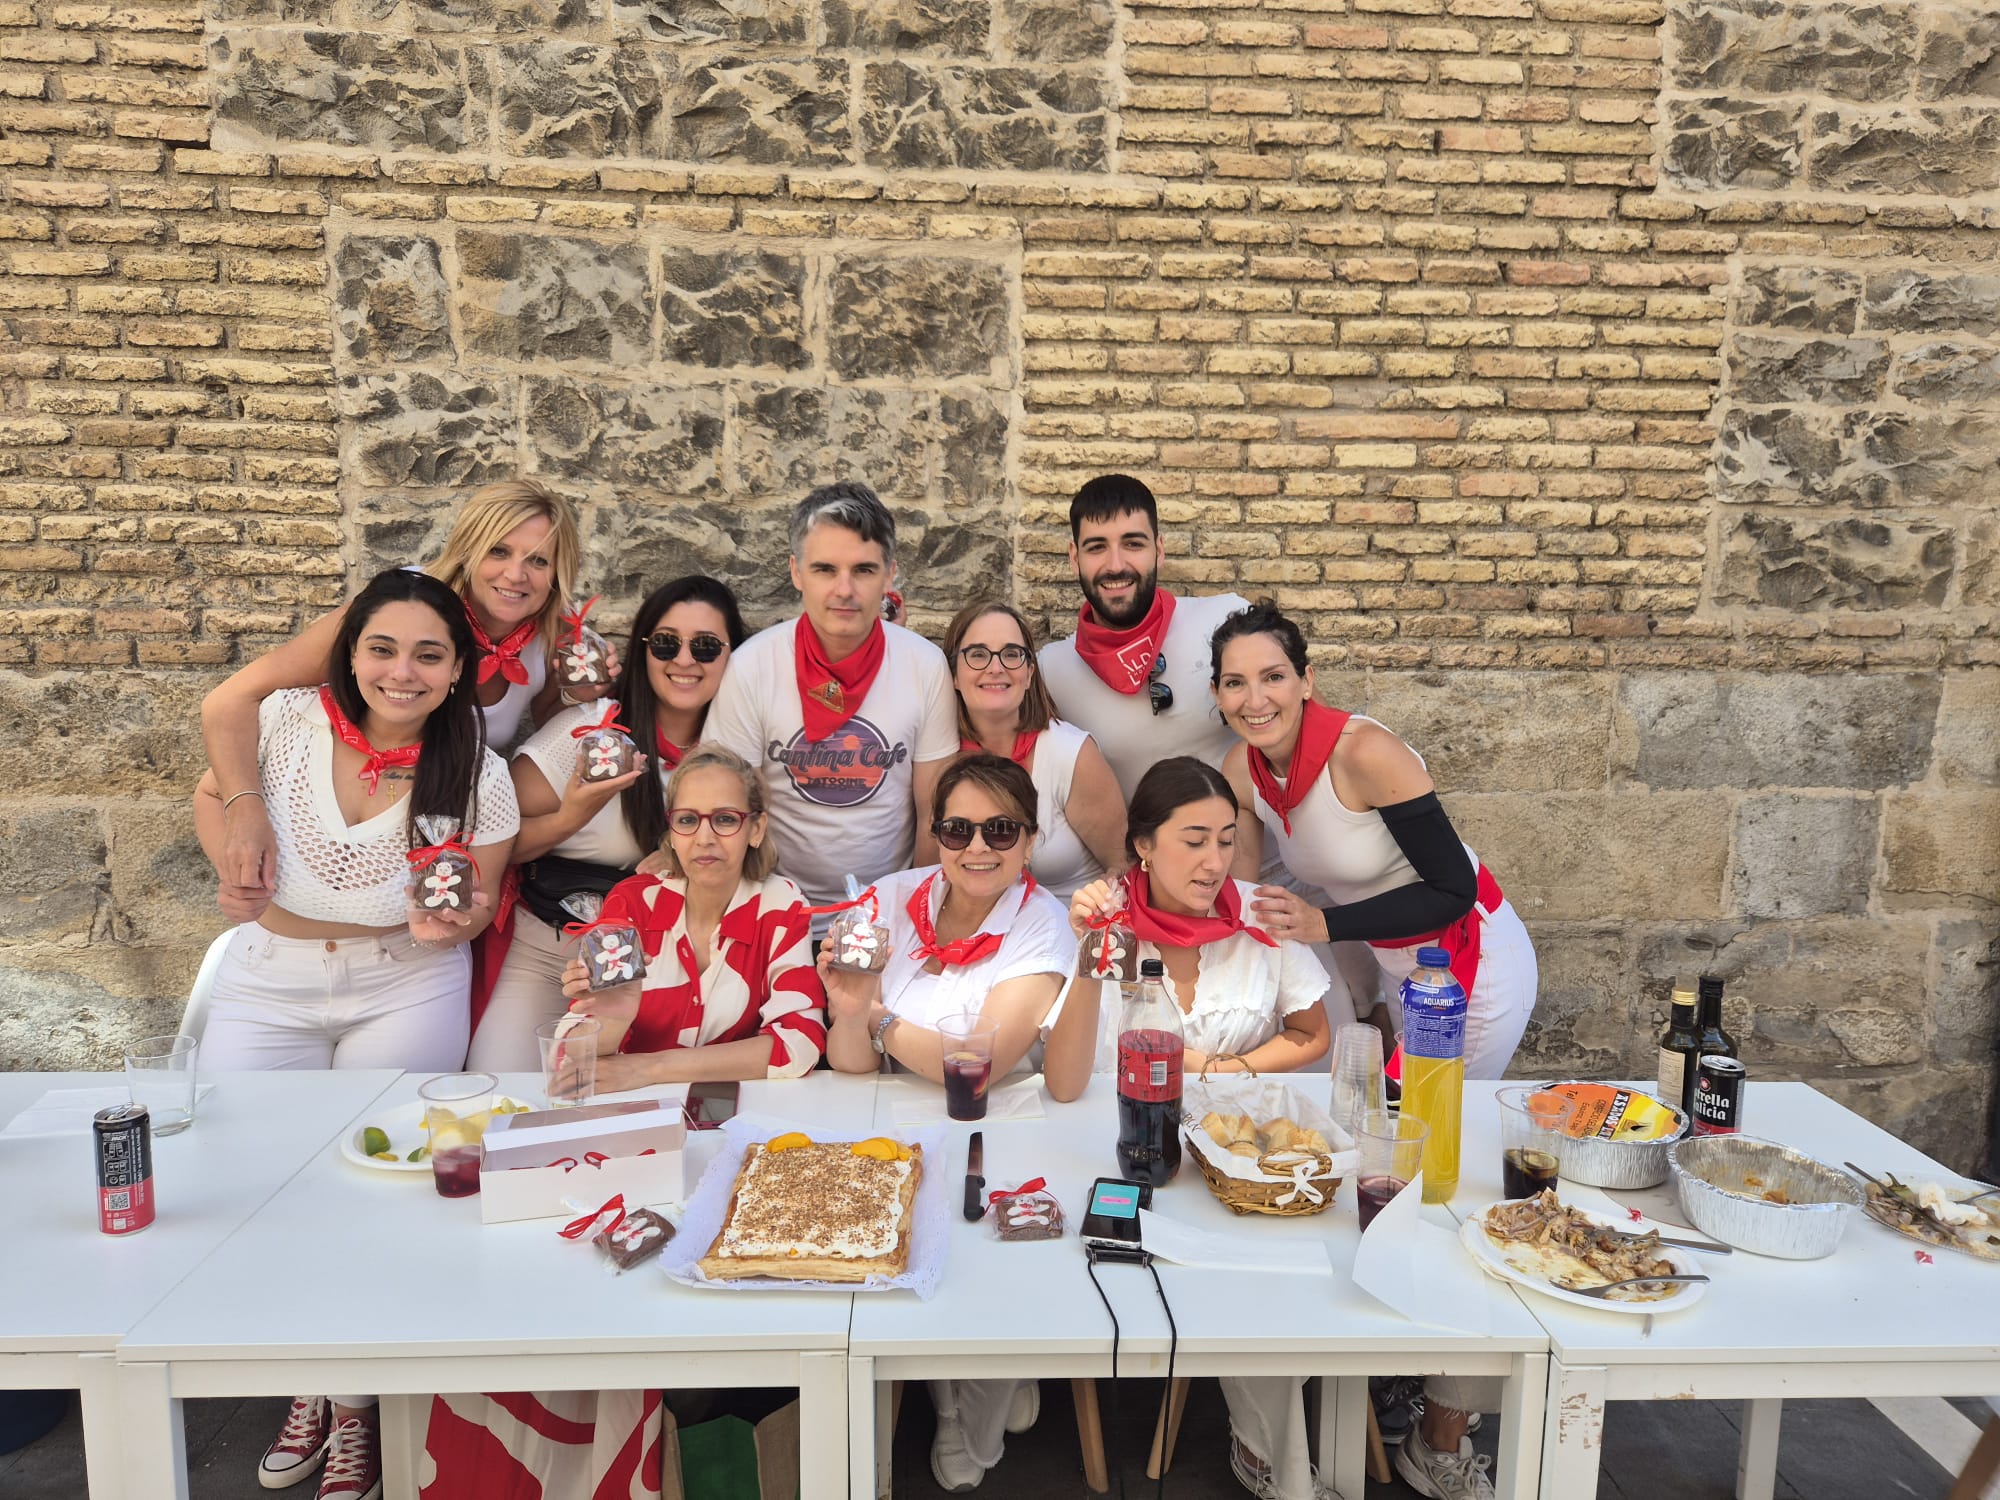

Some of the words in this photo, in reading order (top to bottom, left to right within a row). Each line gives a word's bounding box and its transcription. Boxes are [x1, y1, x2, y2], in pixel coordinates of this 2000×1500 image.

[768, 739, 853, 773] Cantina
[1423, 997, 1455, 1007] AQUARIUS
[1696, 1088, 1730, 1109] trella
[1605, 1093, 1629, 1126] ASADOS
[1695, 1101, 1727, 1121] alicia
